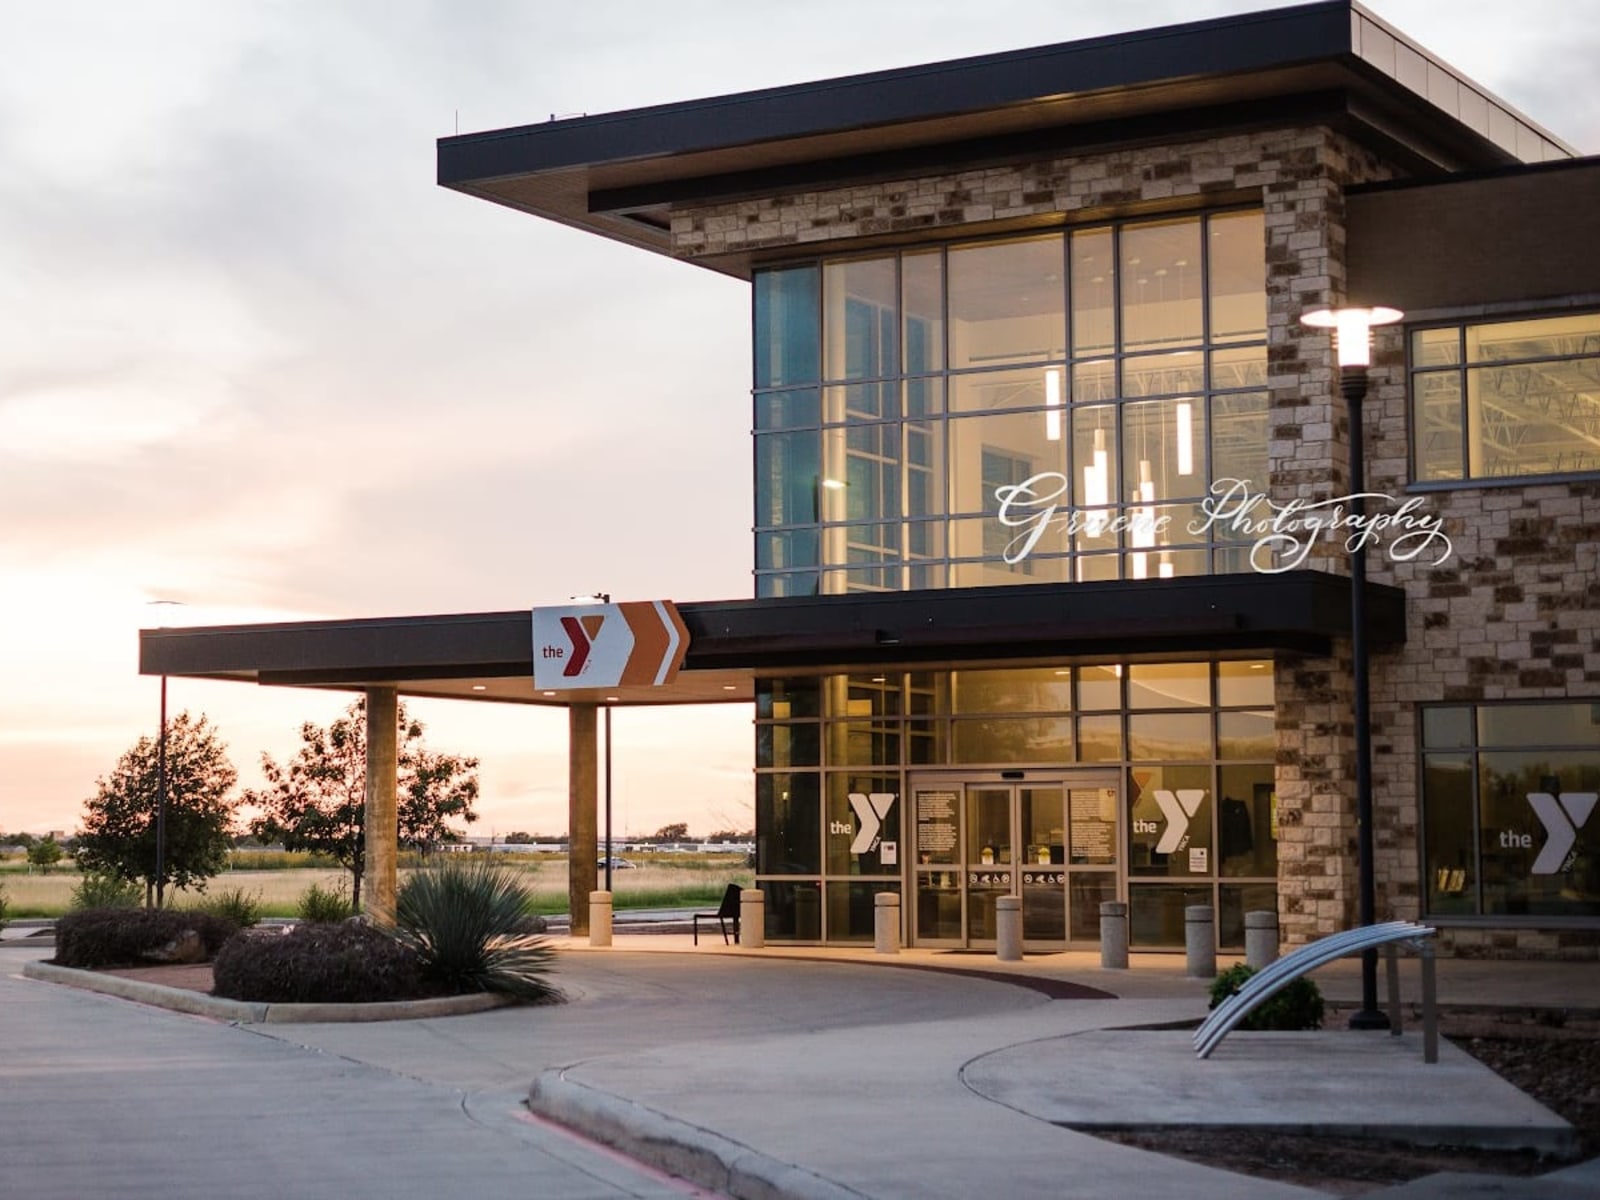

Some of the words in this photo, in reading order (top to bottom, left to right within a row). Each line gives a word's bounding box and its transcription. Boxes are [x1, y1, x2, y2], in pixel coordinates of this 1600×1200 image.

[542, 645, 564, 659] the
[830, 820, 852, 835] the
[1133, 819, 1157, 834] the
[1499, 829, 1532, 848] the
